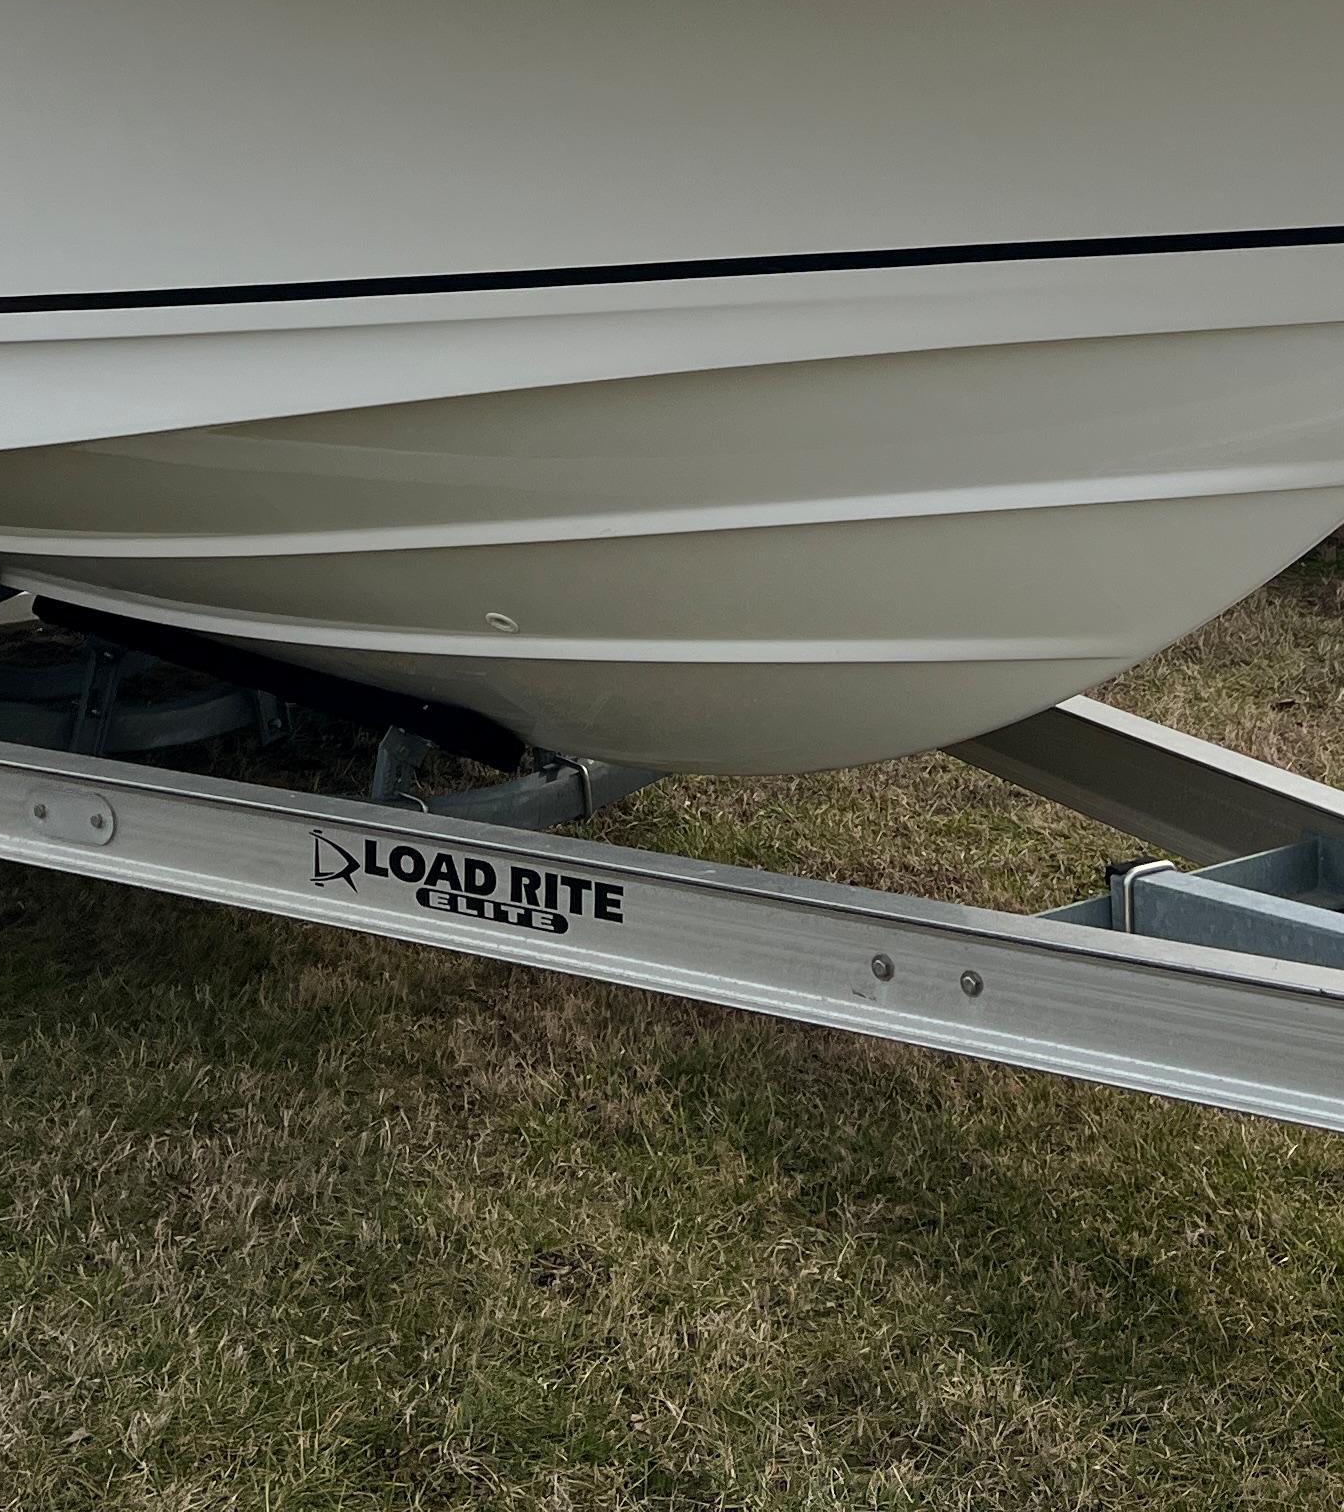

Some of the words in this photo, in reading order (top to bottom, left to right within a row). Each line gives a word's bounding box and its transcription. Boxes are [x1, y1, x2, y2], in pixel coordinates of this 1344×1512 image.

[364, 839, 497, 896] LOAD
[510, 866, 624, 924] RITE
[428, 890, 556, 931] ELITE
